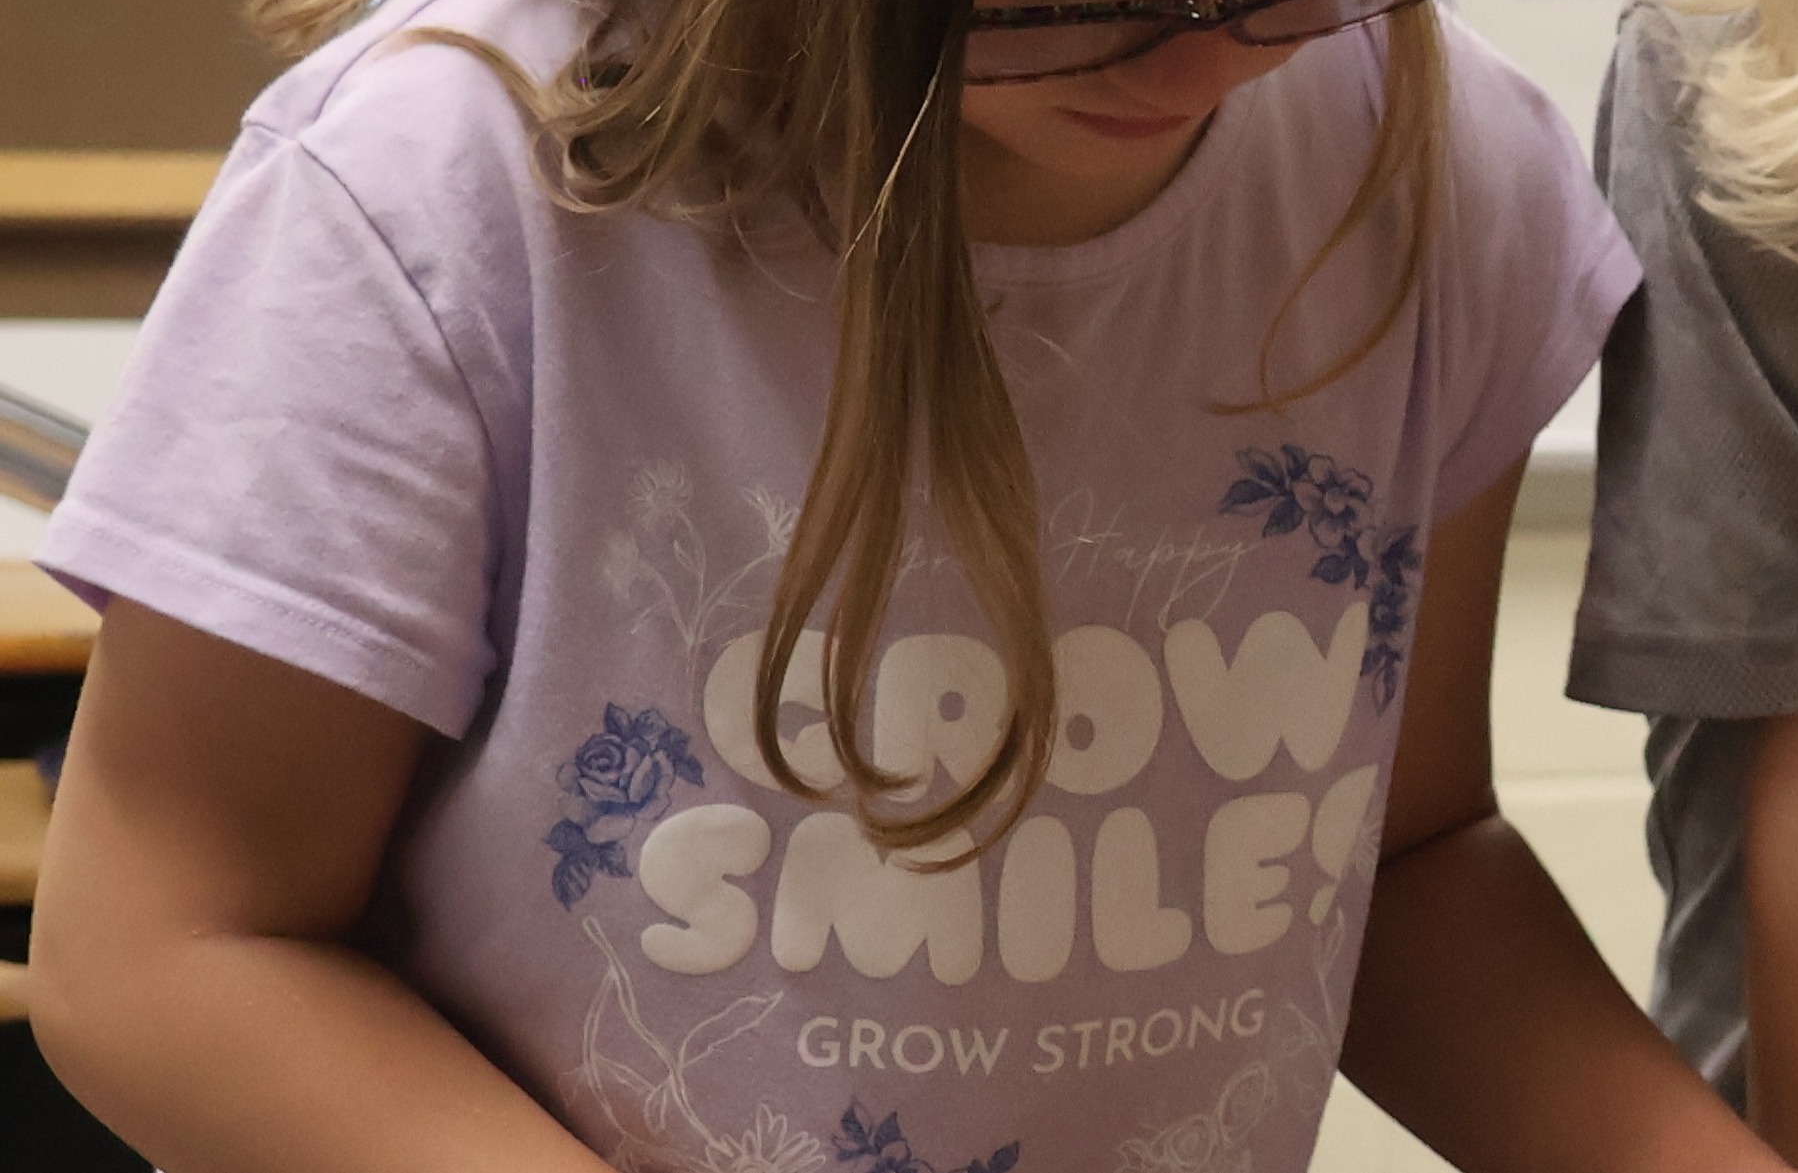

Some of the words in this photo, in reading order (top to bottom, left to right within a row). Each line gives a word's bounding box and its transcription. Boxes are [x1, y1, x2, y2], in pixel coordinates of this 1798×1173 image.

[703, 601, 1369, 802] GROW
[798, 1016, 1008, 1076] GROW
[1031, 988, 1265, 1074] STRONG
